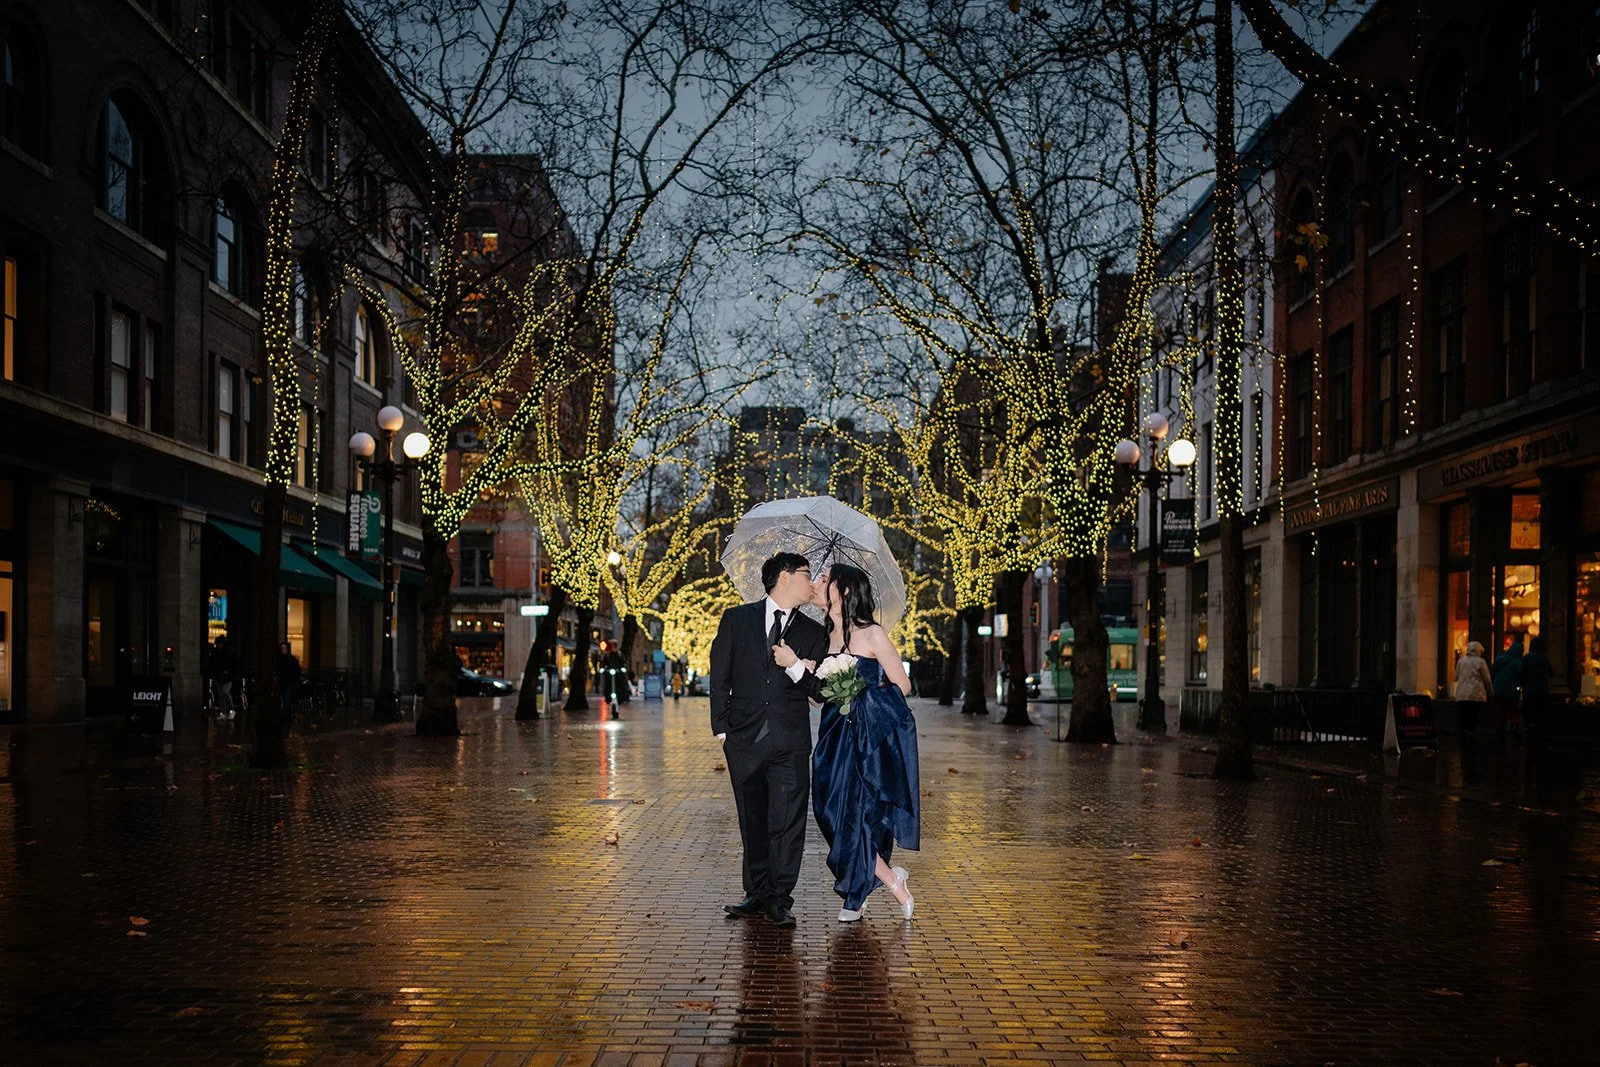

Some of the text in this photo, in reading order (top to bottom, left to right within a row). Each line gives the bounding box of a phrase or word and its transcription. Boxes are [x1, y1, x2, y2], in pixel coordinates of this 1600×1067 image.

[349, 494, 360, 551] SQUARE
[360, 494, 381, 539] Pioneer
[133, 691, 162, 701] LEICHT
